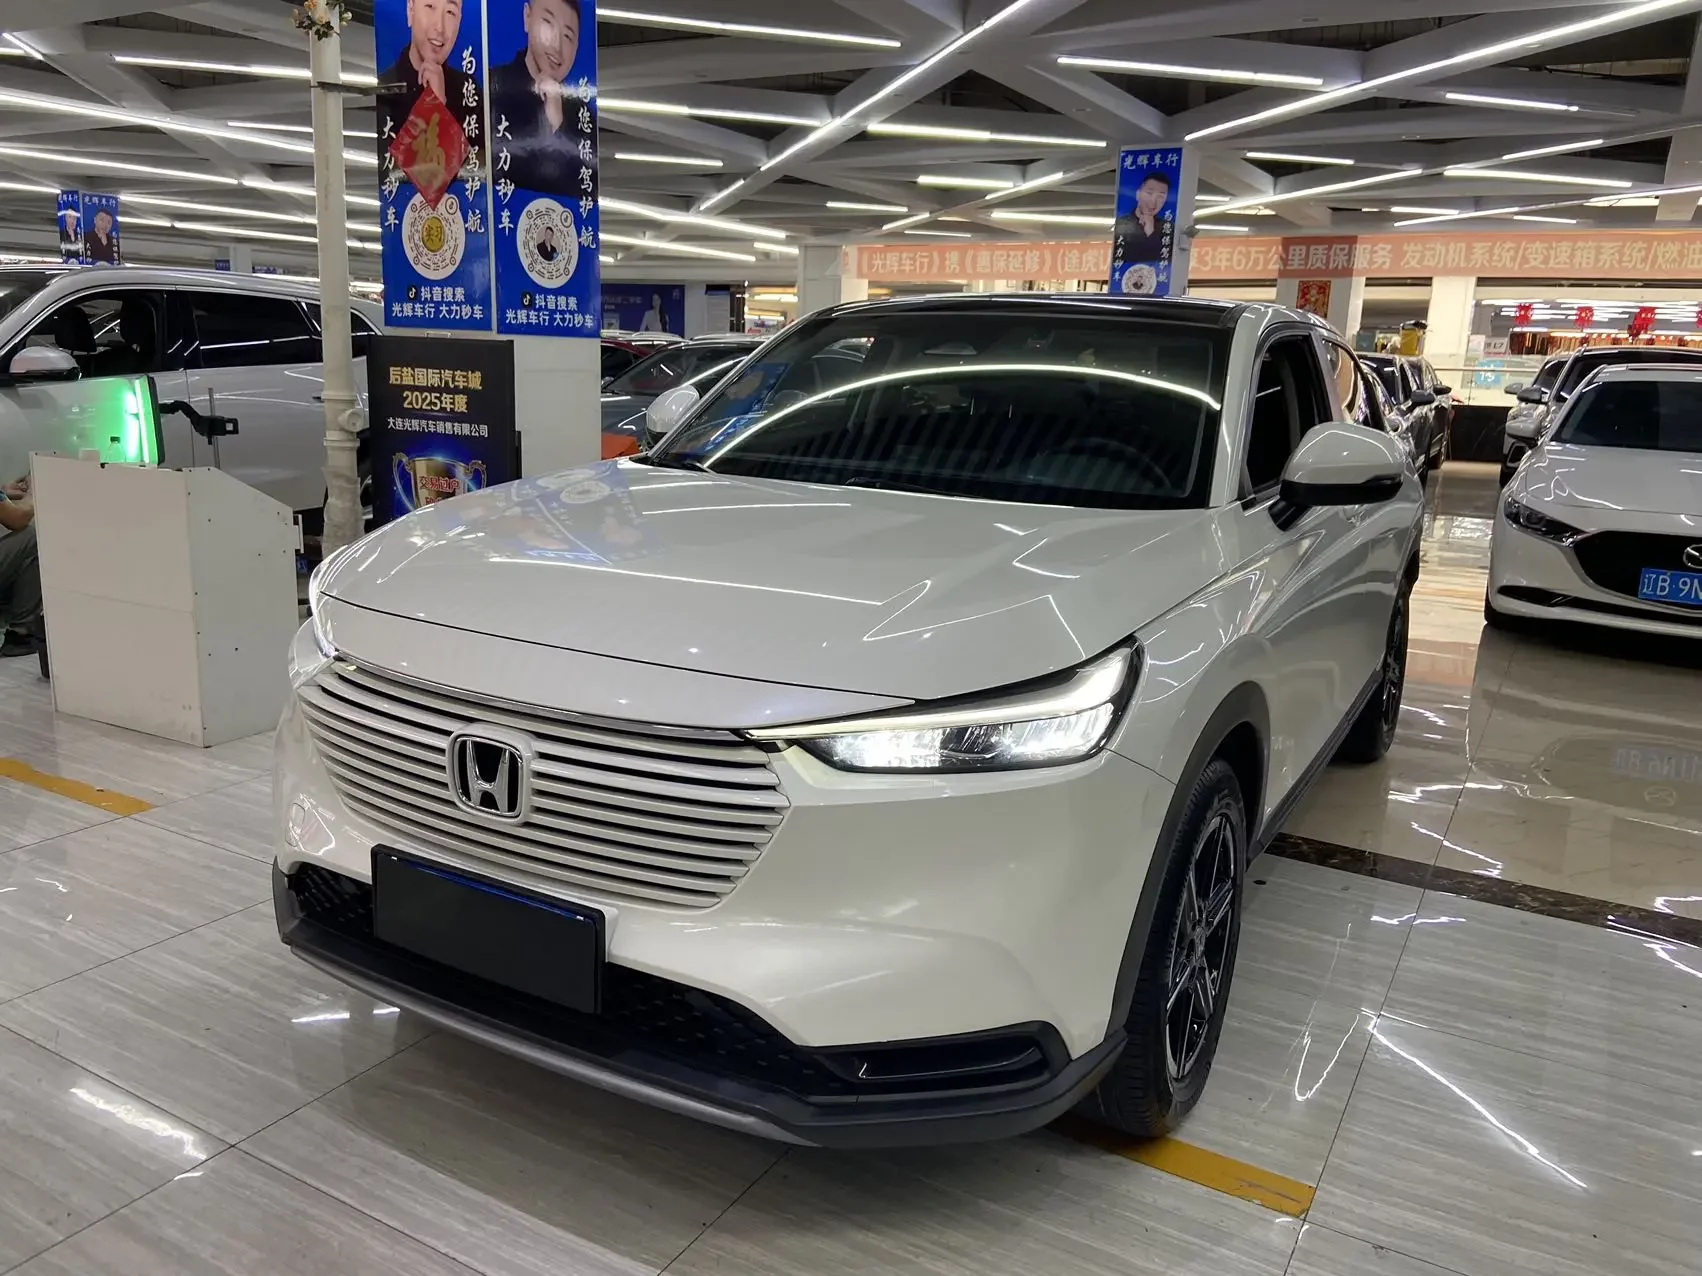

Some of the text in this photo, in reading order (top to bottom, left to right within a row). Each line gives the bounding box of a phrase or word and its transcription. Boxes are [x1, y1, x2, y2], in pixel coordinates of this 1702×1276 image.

[461, 46, 485, 233] 为您保驾护航
[577, 76, 597, 249] 为您保驾护航
[496, 114, 515, 236] 大力秒车
[421, 286, 465, 302] 抖音搜索
[535, 293, 578, 311] 抖音搜索
[392, 303, 484, 320] 光辉车行 大力秒车
[506, 309, 594, 328] 光辉车行 大力秒车
[389, 366, 482, 390] 后盐国际汽车城
[403, 391, 468, 413] 2025年度
[387, 417, 488, 438] 大连光辉汽车销售有限公司
[419, 475, 459, 492] 交易过户
